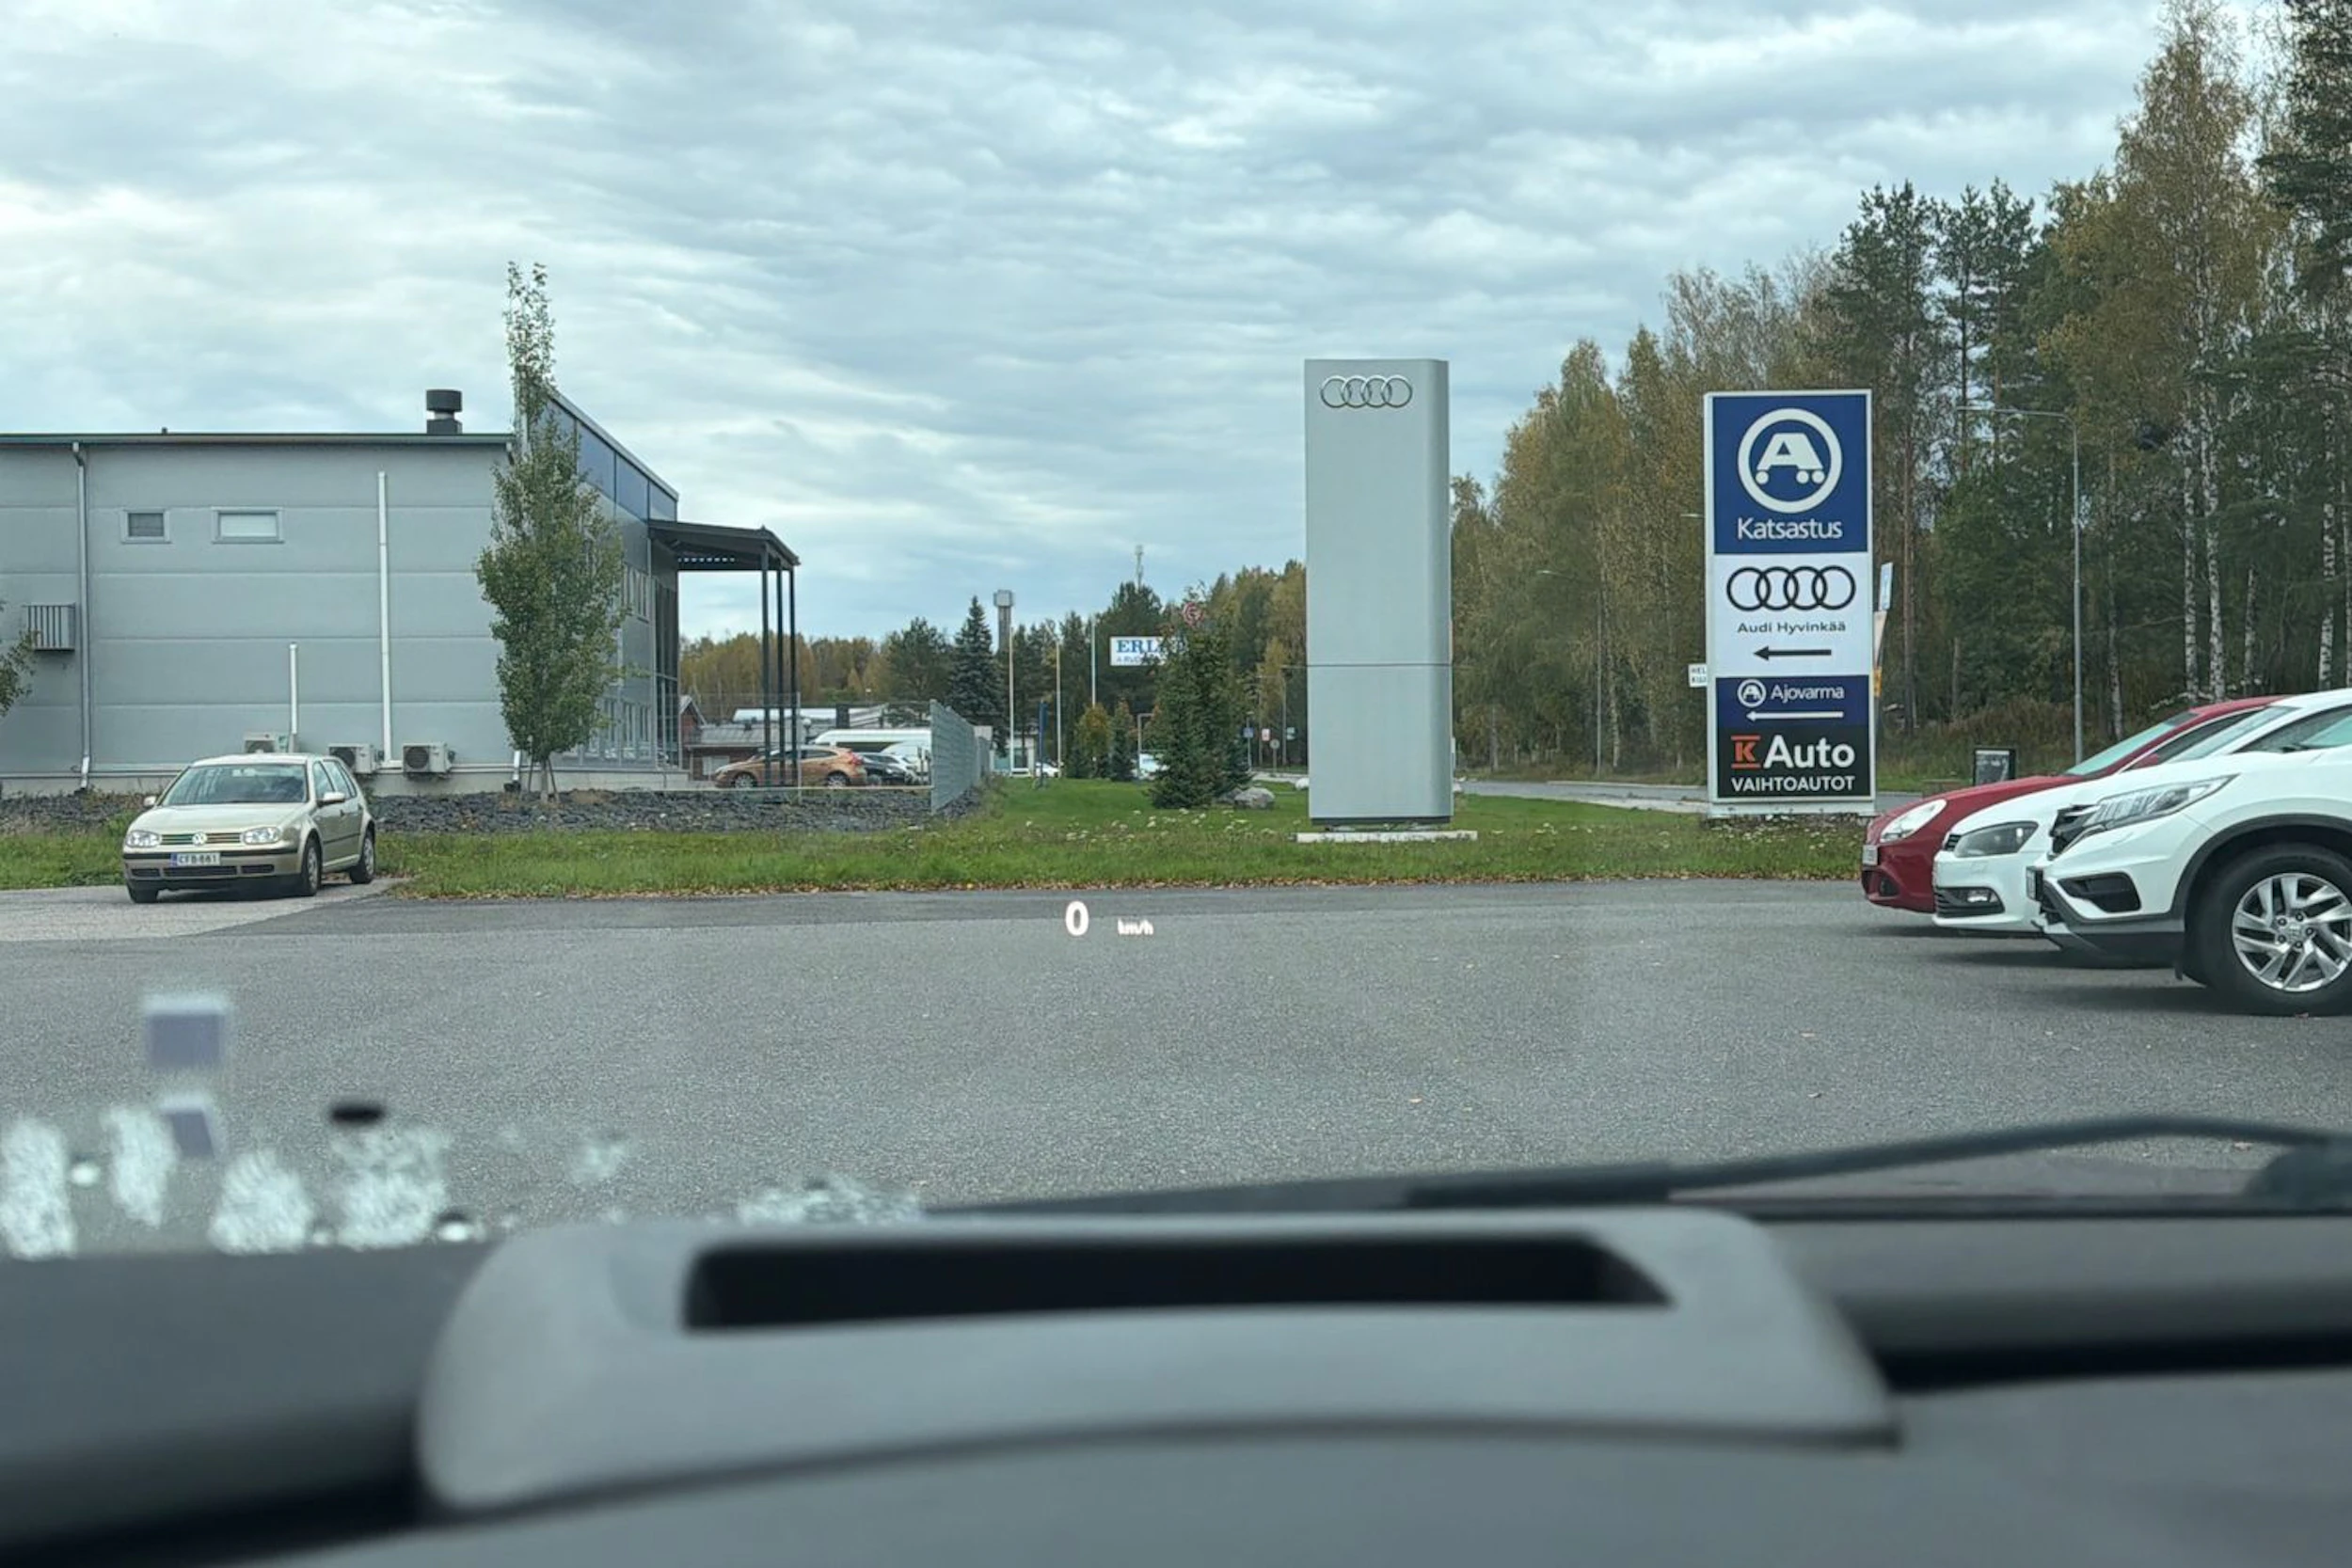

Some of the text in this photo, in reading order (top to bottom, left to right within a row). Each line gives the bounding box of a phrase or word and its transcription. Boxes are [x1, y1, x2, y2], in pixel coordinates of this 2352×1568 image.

[1738, 517, 1843, 540] Katsastus
[1738, 621, 1846, 635] Audi Hyvinkää
[1771, 684, 1845, 704] Ajovarma
[1763, 735, 1855, 768] Auto
[1731, 775, 1855, 792] VAIHTOAUTOT
[1065, 900, 1154, 937] 0 km/h
